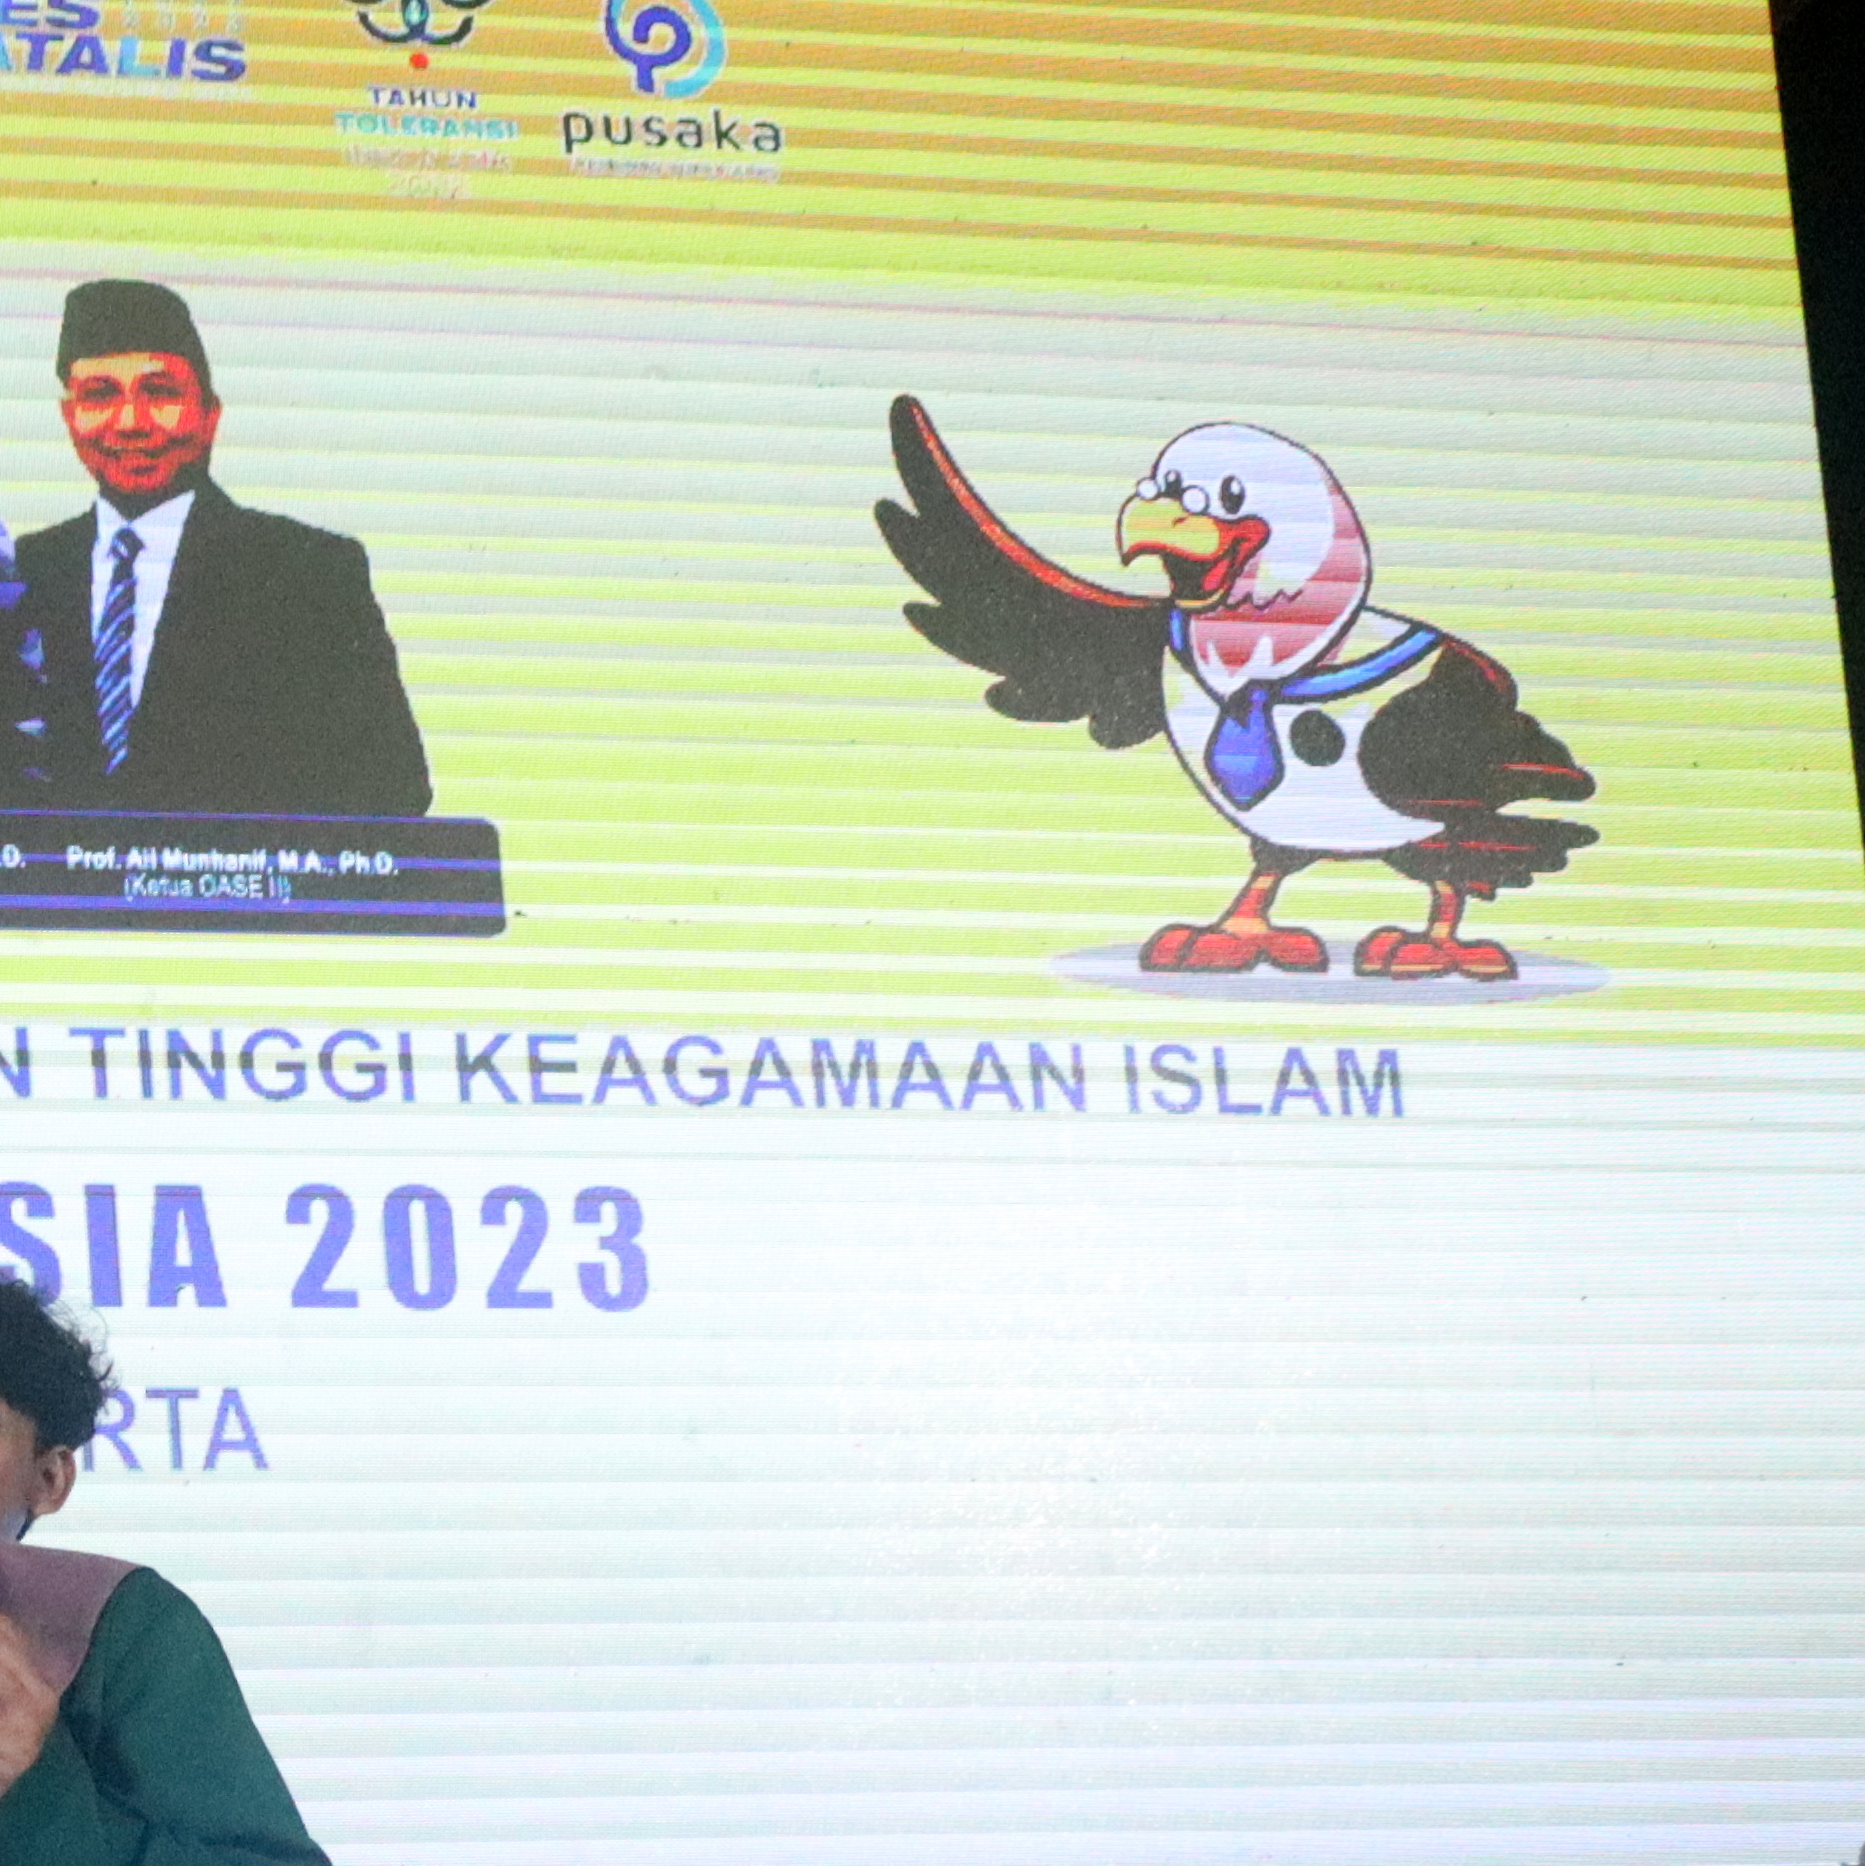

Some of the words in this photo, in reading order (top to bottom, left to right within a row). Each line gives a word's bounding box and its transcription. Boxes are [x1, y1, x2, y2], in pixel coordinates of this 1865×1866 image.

[367, 86, 478, 109] TAHUN
[563, 110, 782, 154] pusaka
[65, 844, 122, 870] Prof.
[126, 846, 156, 870] Ali
[338, 850, 399, 876] Ph.D.
[198, 876, 263, 897] OASE
[69, 1026, 416, 1102] TINGGI
[453, 1033, 1087, 1112] KEAGAMAAN
[1124, 1043, 1403, 1118] ISLAM
[285, 1182, 649, 1312] 2023
